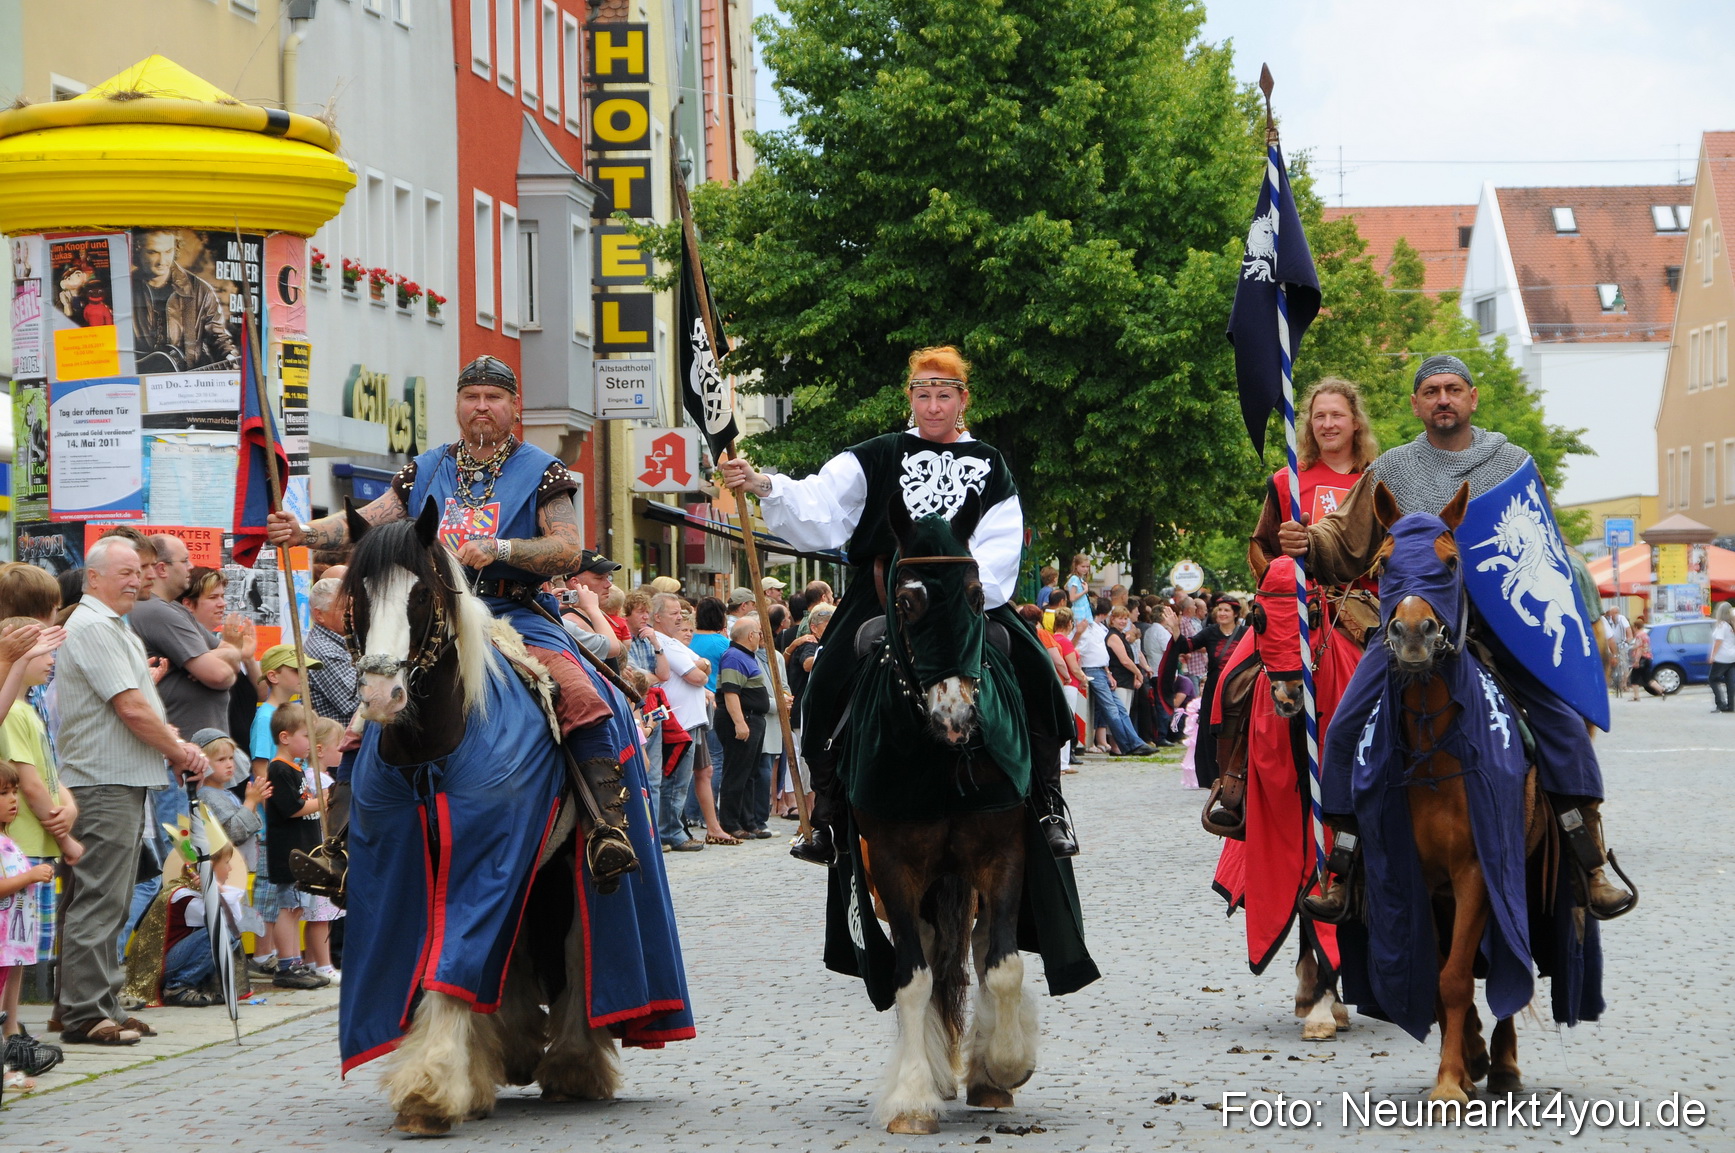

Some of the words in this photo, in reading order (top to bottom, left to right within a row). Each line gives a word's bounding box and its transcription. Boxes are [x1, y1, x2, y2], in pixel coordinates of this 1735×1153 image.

[591, 29, 650, 345] HOTEL
[50, 244, 63, 252] Jim
[64, 240, 89, 251] Knopf
[90, 239, 107, 249] und
[50, 252, 72, 261] Lukas
[215, 260, 259, 283] BENER
[229, 293, 259, 314] BAD
[599, 364, 651, 373] Altstadthotel
[165, 380, 181, 389] Do.
[184, 379, 192, 388] 2.
[194, 379, 214, 388] Juni
[216, 379, 226, 387] im
[605, 377, 645, 389] Stern
[58, 409, 70, 418] Tag
[71, 408, 83, 416] der
[85, 407, 114, 416] offenen
[115, 406, 129, 415] Tür
[186, 416, 238, 425] www.markben
[286, 413, 304, 423] Neues
[67, 439, 79, 448] 14.
[80, 438, 96, 448] Mai
[98, 438, 119, 448] 2011
[31, 462, 48, 475] Tod
[60, 511, 132, 520] www.campus-neumarkt.de
[186, 541, 212, 552] EST
